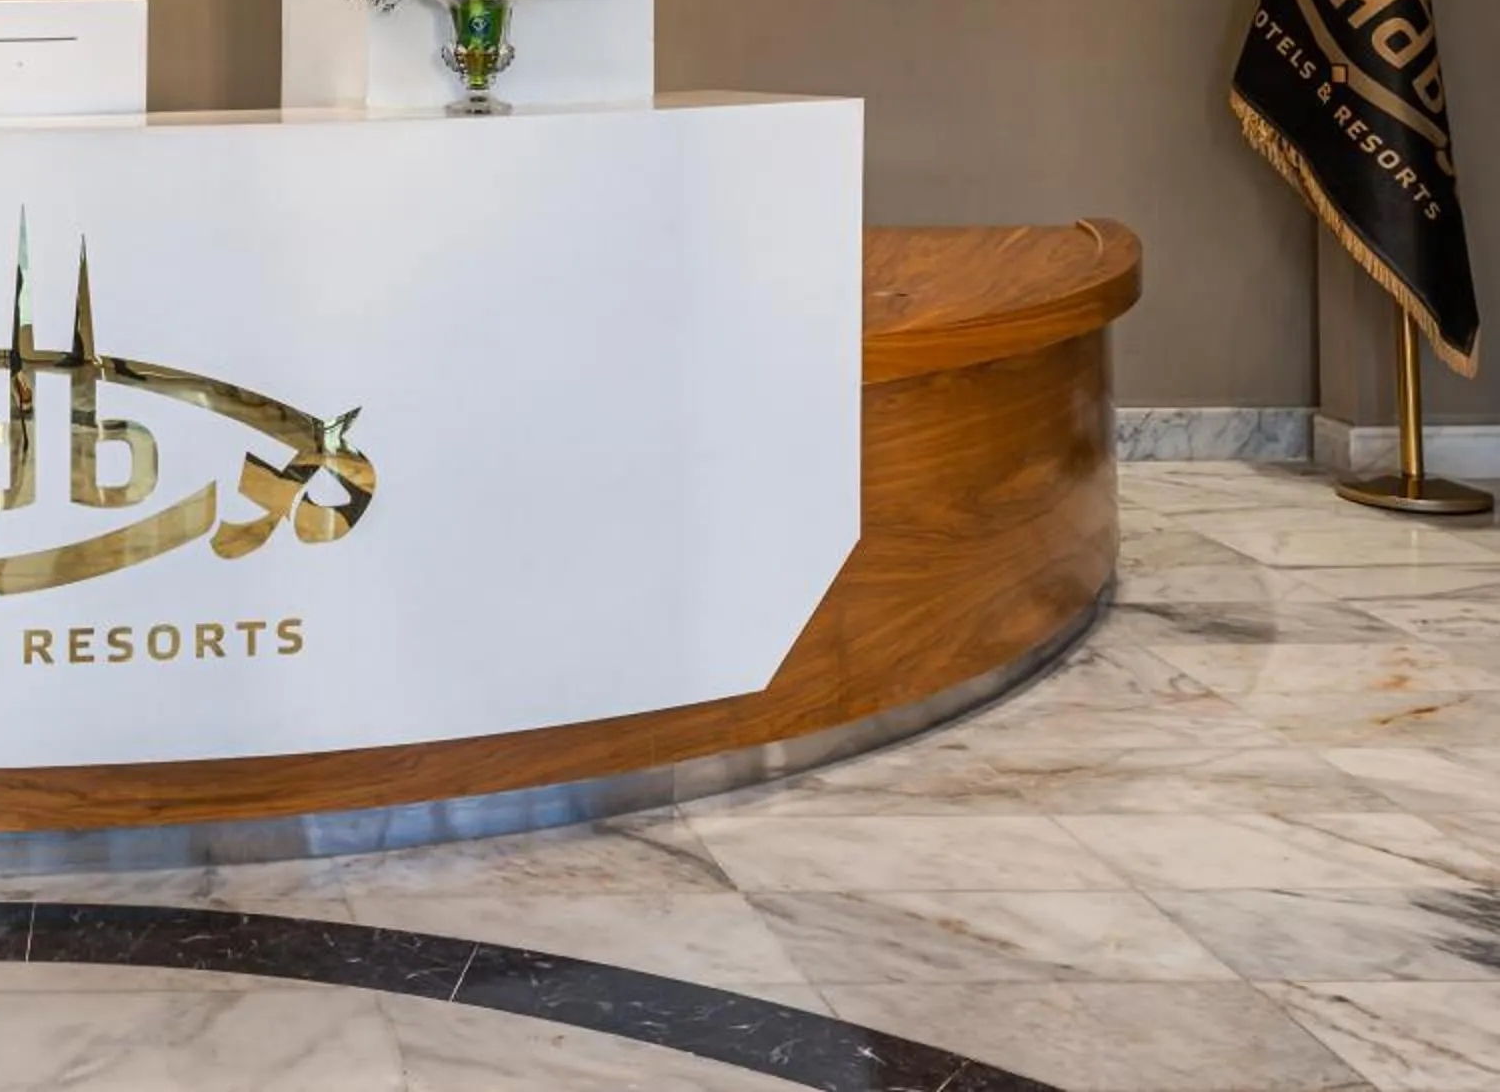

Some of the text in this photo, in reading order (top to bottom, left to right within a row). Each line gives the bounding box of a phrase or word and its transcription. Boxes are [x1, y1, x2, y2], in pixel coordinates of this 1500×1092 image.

[1255, 9, 1317, 79] OTELS
[1333, 105, 1442, 220] RESORTS
[22, 617, 306, 665] RESORTS
